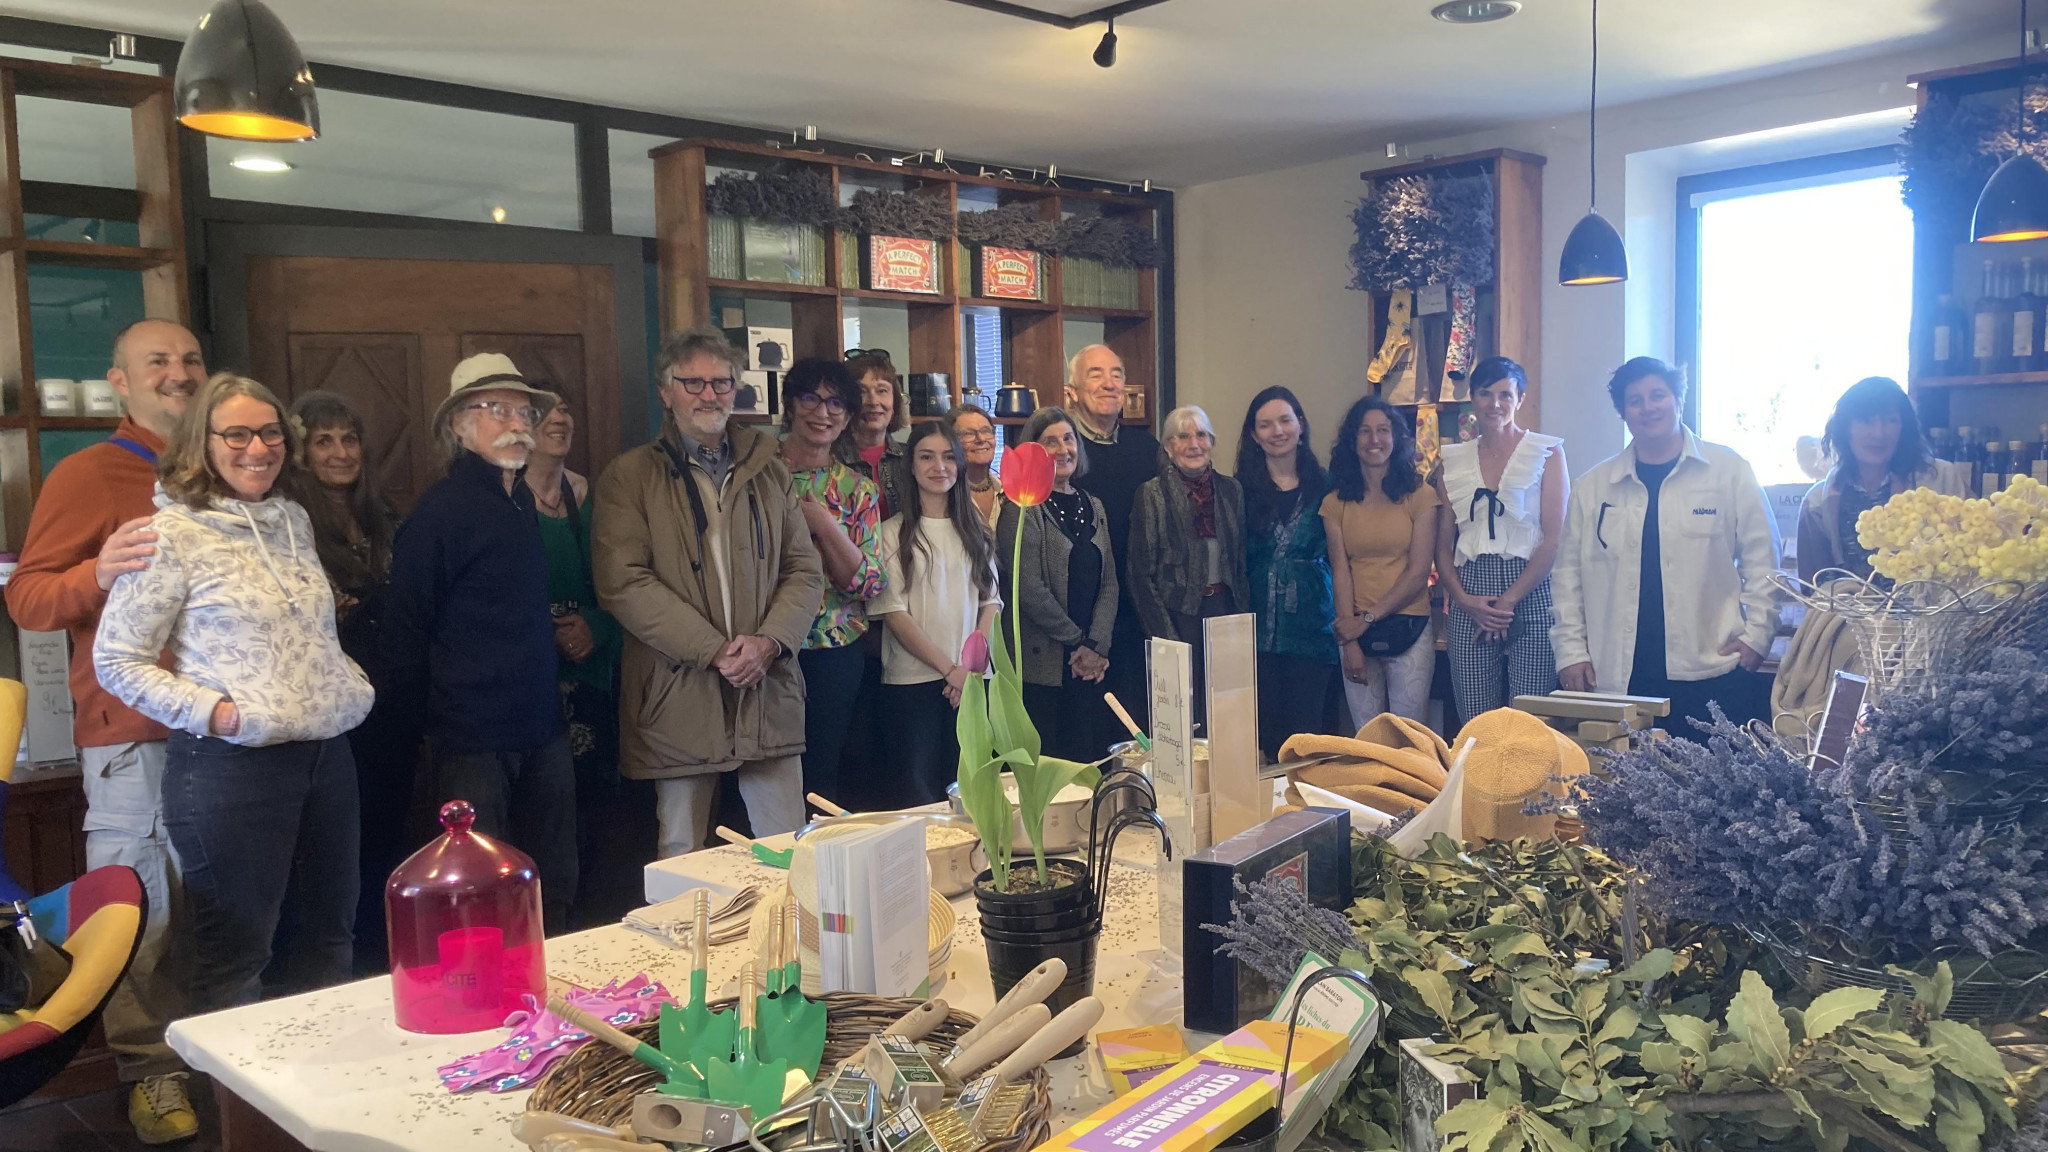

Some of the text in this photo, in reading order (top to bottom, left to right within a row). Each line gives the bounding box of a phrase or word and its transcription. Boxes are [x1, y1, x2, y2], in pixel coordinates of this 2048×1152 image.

[893, 250, 921, 262] PERFECT
[892, 266, 917, 275] MATCH
[1002, 260, 1027, 272] PERFECT
[1001, 275, 1023, 284] MATCH
[1779, 495, 1802, 504] LA CI
[1326, 986, 1344, 1003] BARATON
[1306, 1003, 1322, 1022] fiches
[1321, 1018, 1331, 1030] du
[1104, 1073, 1211, 1137] ENCENS DE JARDIN PARFUMÉS
[1112, 1073, 1241, 1149] CITRONNELLE
